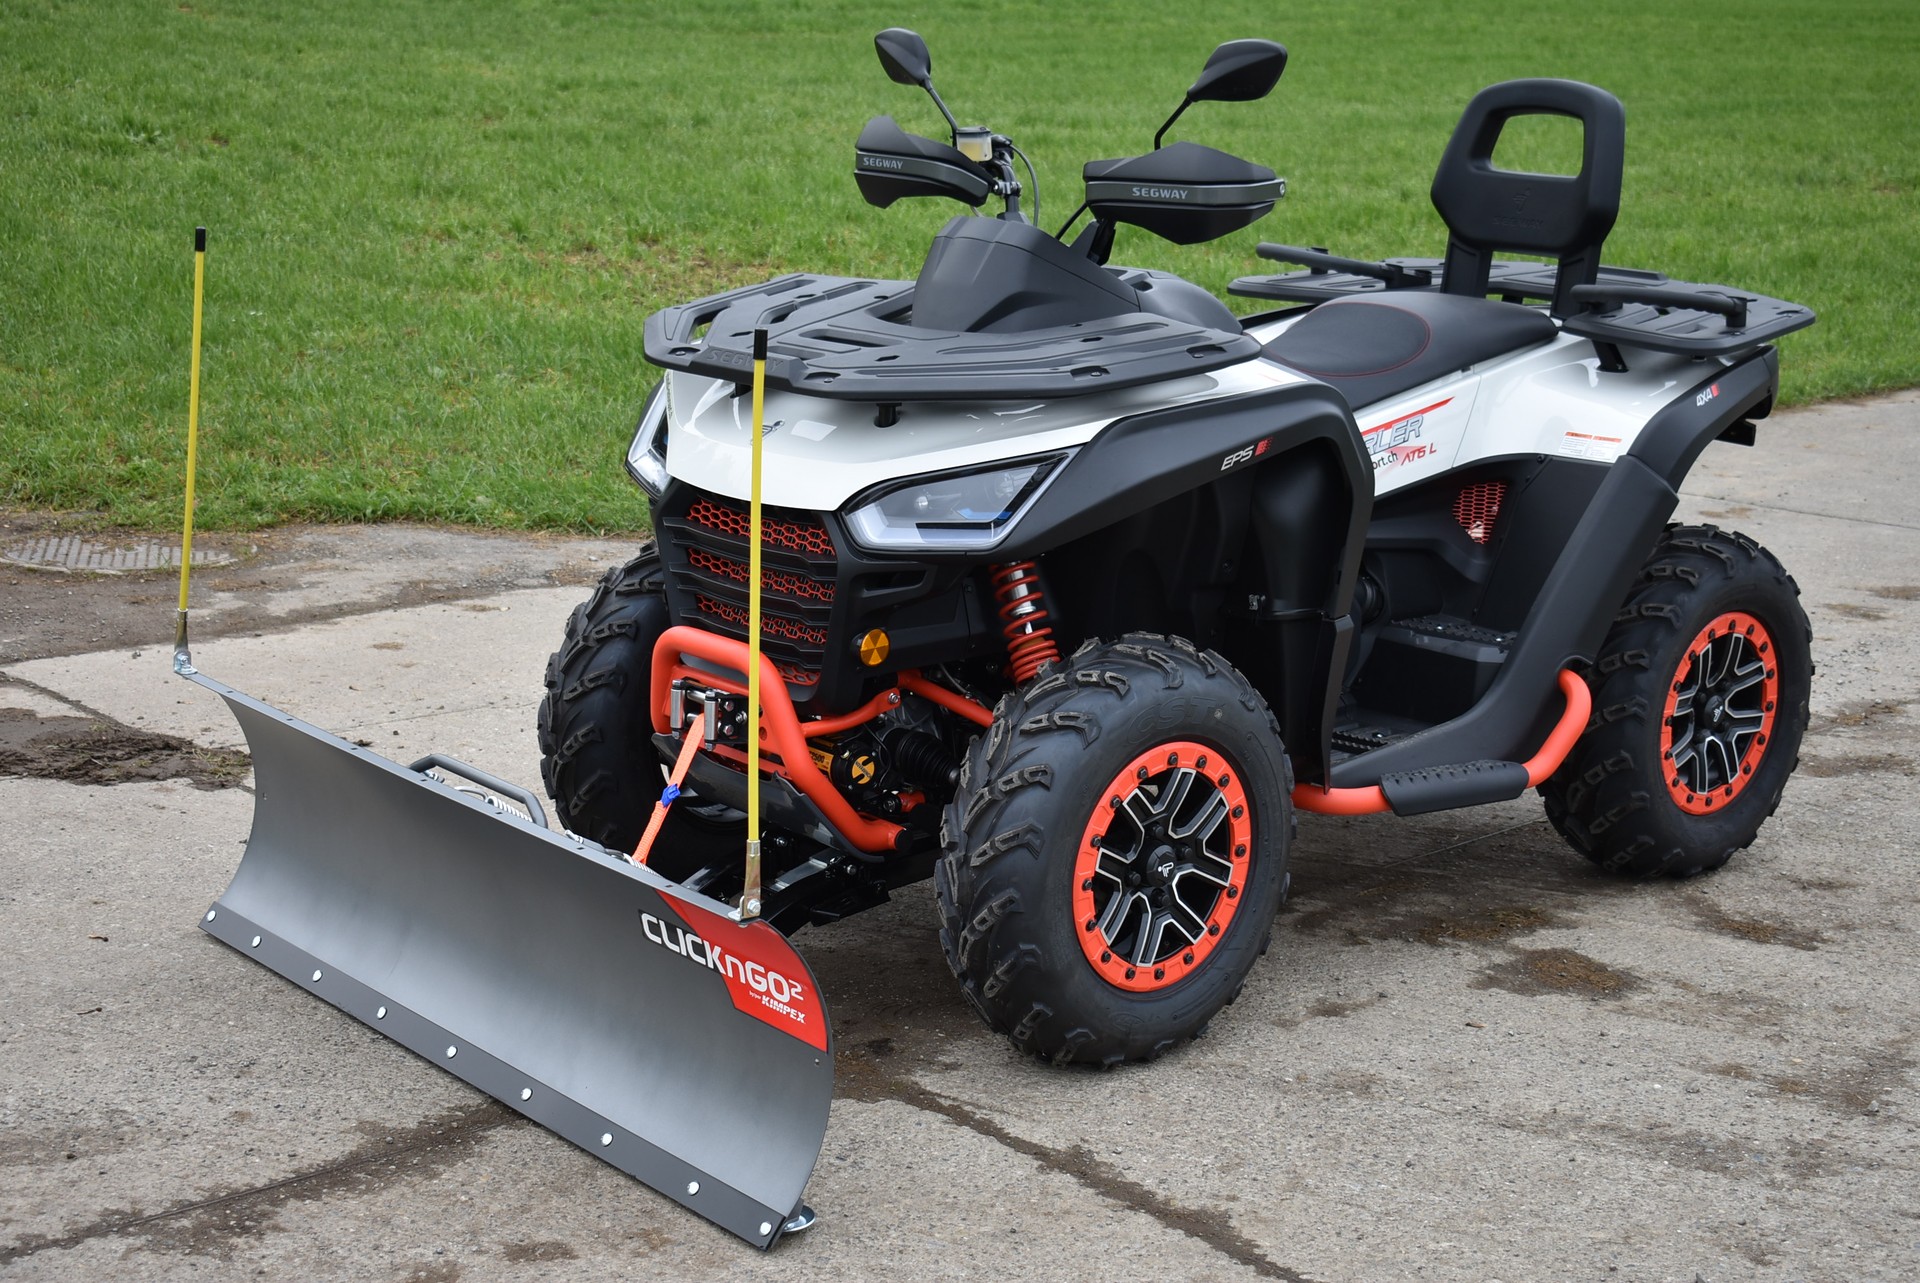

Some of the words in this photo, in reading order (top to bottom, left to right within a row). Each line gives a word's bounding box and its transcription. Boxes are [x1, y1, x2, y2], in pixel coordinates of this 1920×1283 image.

[863, 157, 904, 170] SEGWAY
[1131, 186, 1189, 200] SEGWAY
[1429, 442, 1438, 455] L
[1220, 445, 1255, 471] EPS
[761, 994, 806, 1025] KIMPEX
